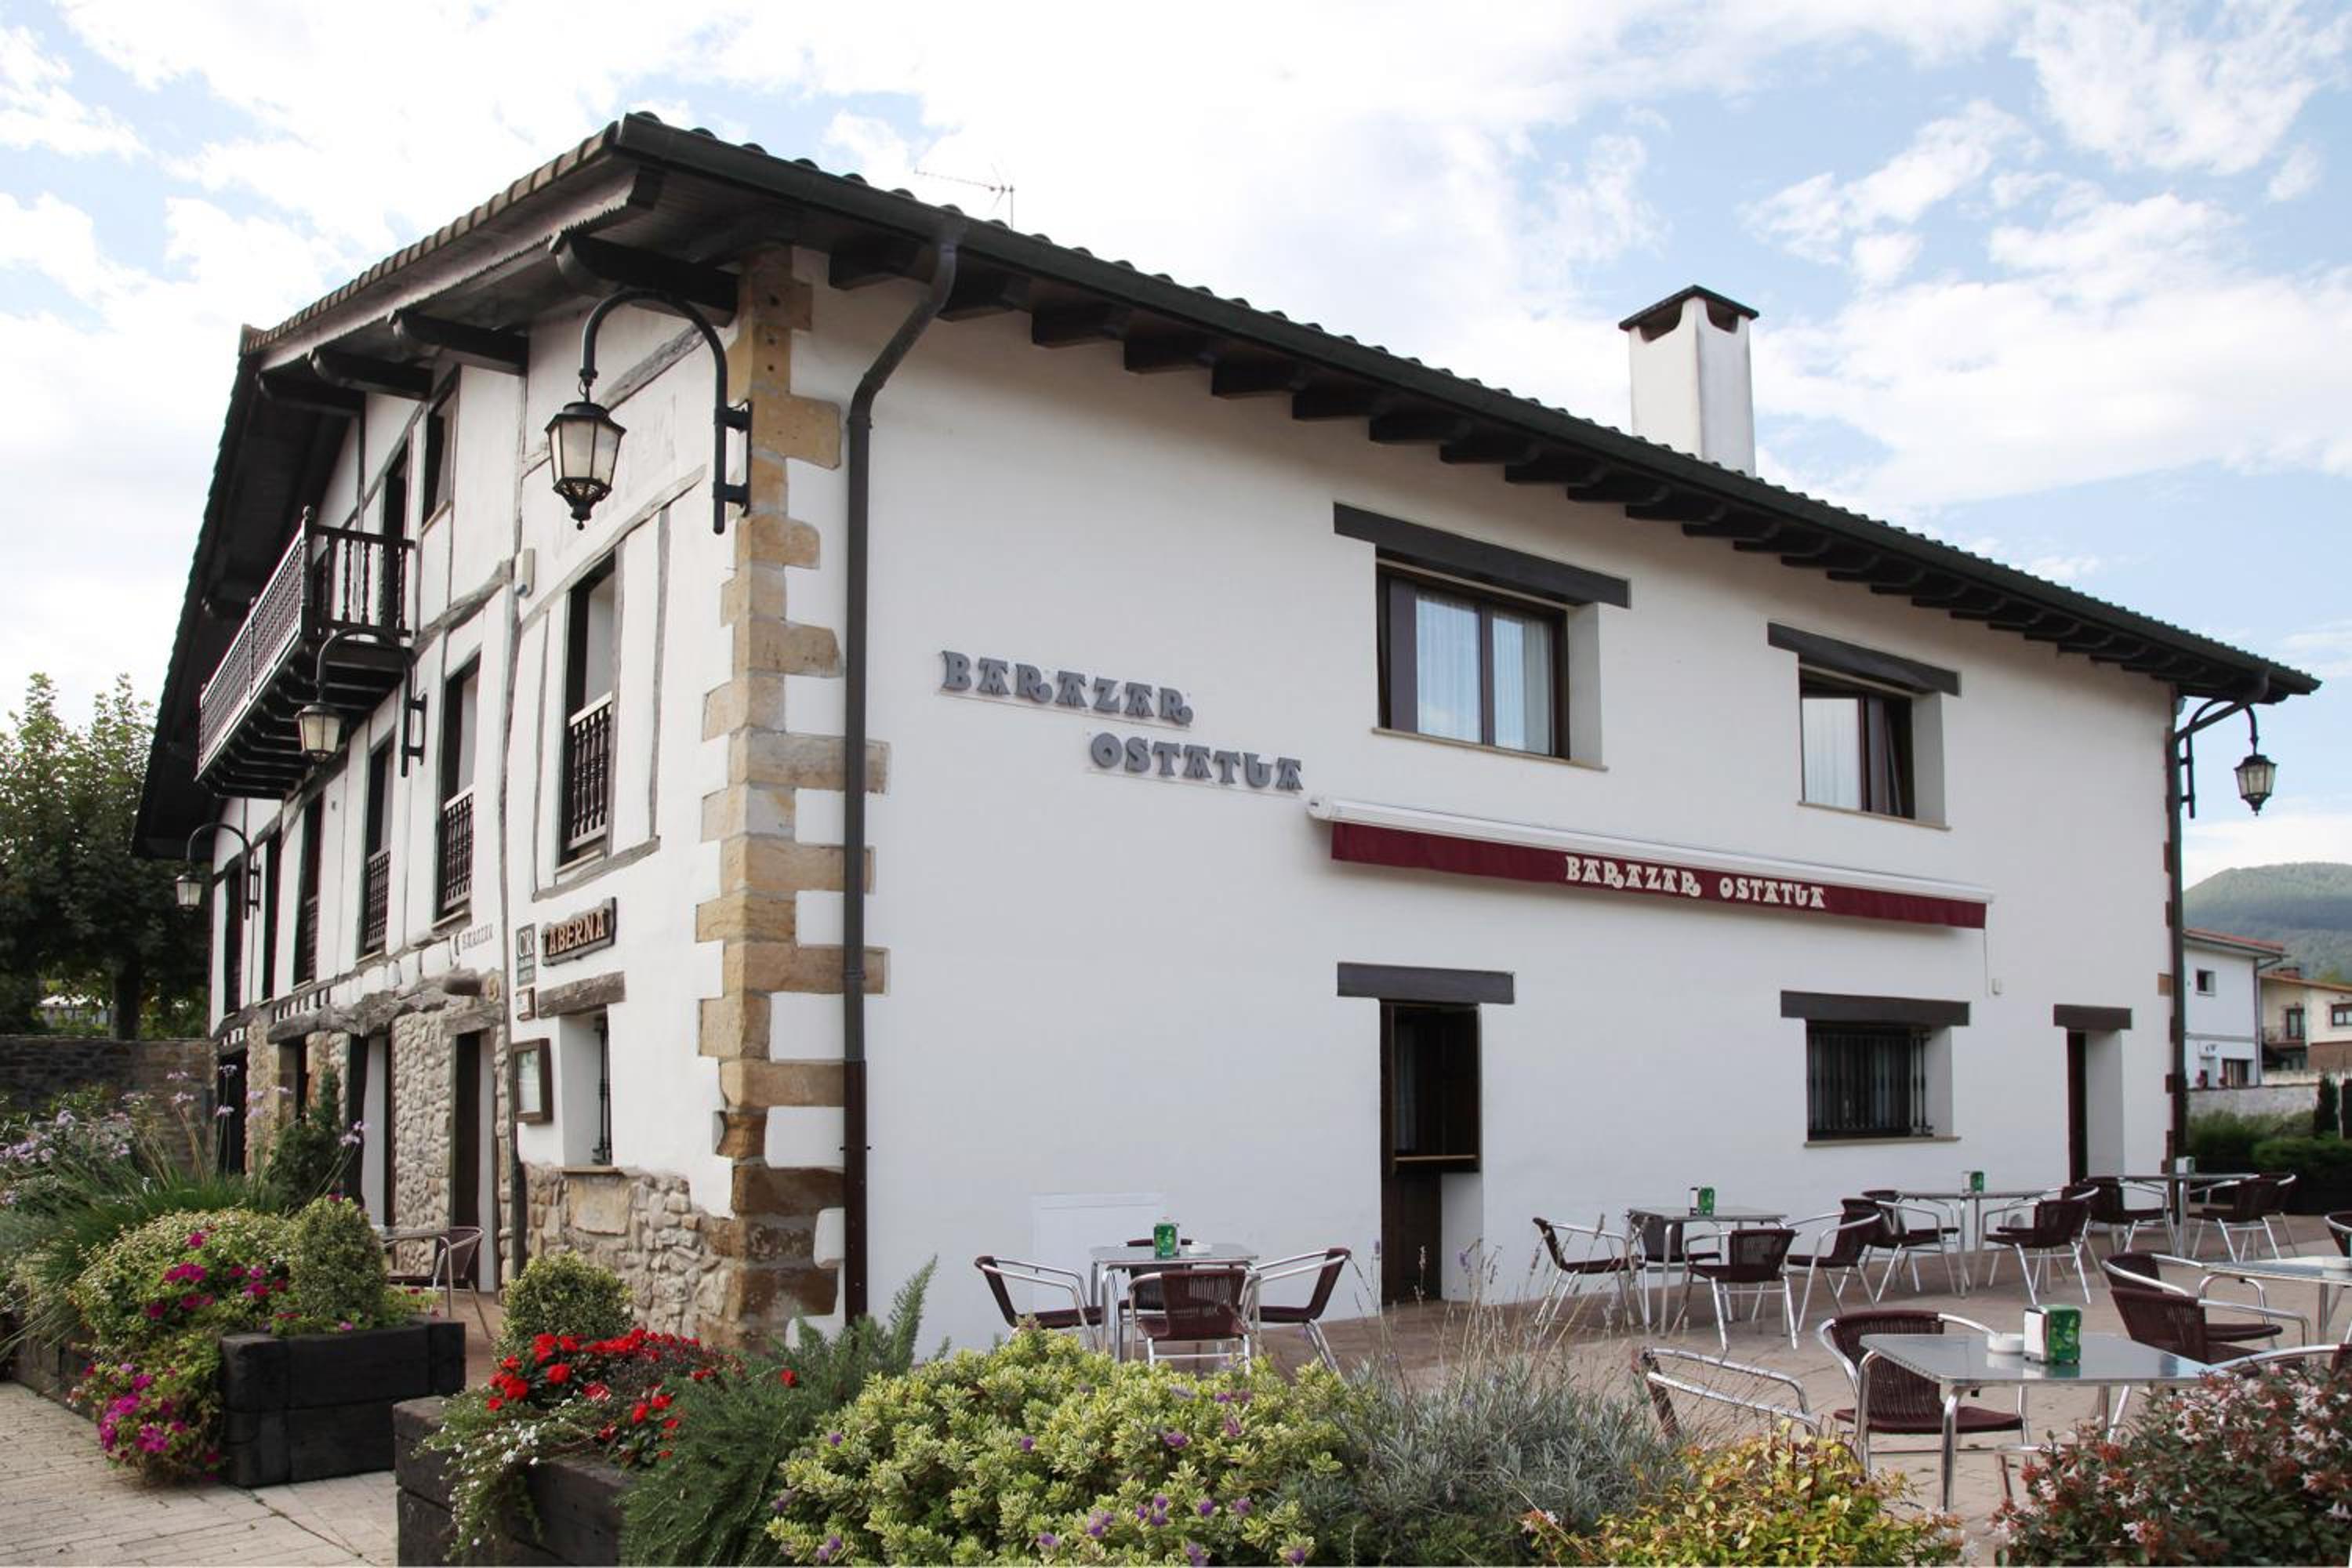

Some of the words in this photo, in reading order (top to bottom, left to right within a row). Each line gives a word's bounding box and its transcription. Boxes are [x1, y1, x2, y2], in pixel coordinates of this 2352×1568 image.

[941, 650, 1193, 724] BARAZAR
[1091, 732, 1303, 790] OSTATUA
[1566, 855, 1701, 898] BARAZAR
[1720, 877, 1825, 909] OSTATUA
